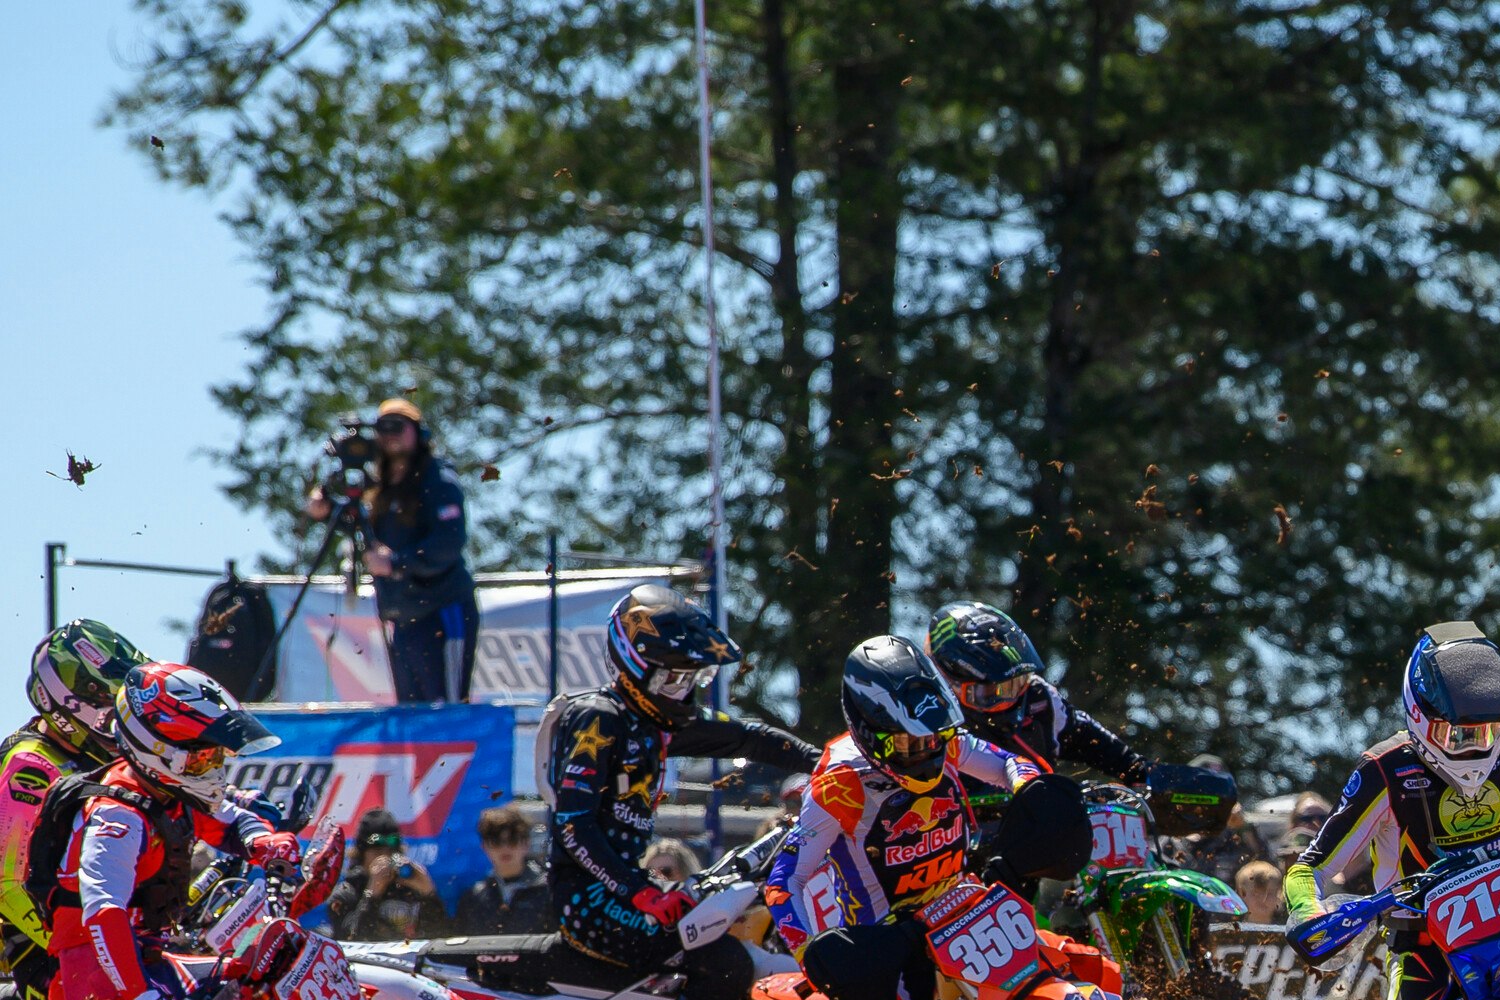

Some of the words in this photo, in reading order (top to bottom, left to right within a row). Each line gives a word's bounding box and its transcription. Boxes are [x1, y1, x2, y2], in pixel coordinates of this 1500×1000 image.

[314, 752, 475, 826] TV
[886, 840, 925, 867] Red
[931, 813, 964, 851] Bull
[1090, 811, 1148, 861] 514
[574, 844, 618, 892] Racing
[894, 849, 964, 895] KTM
[944, 889, 1008, 938] GNCCRACING.COM
[948, 899, 1037, 984] 356
